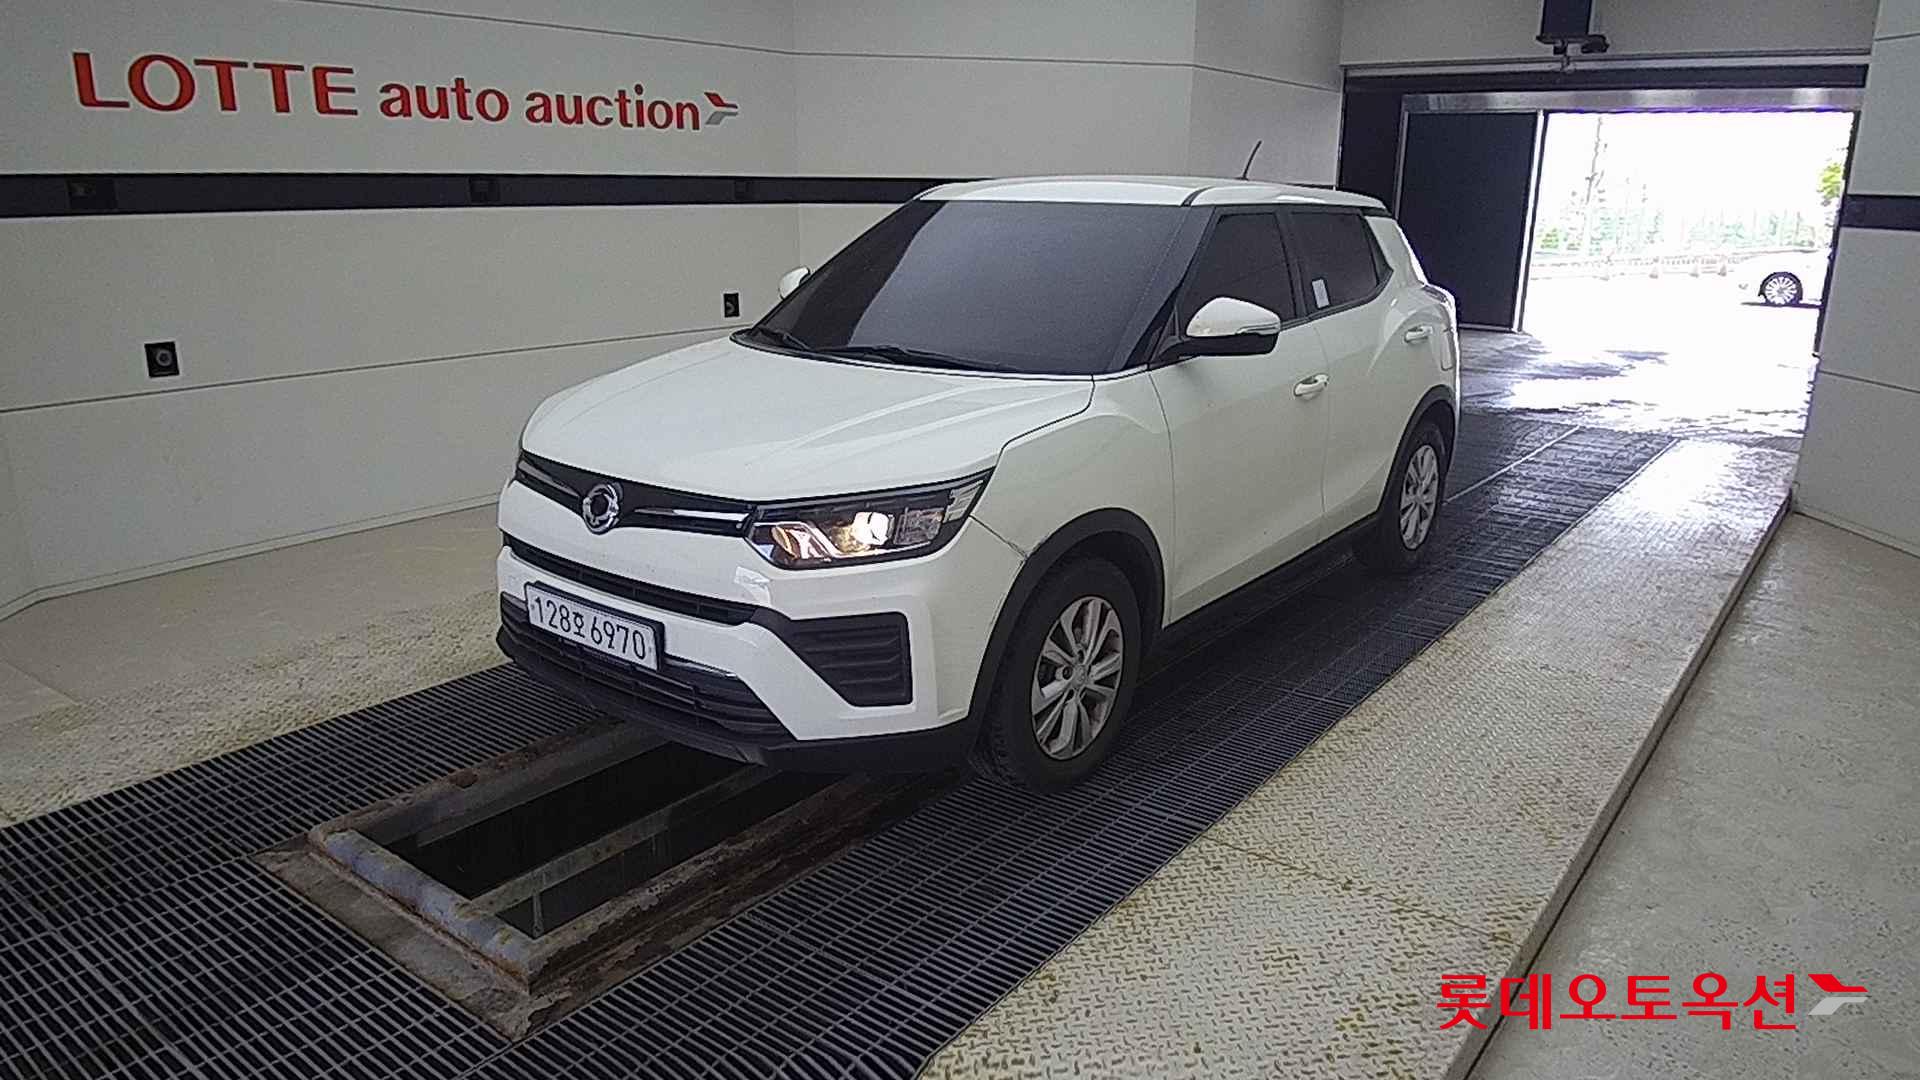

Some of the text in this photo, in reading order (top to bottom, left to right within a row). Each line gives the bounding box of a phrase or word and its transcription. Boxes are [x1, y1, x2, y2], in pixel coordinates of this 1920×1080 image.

[73, 51, 700, 131] LOTTE auto auction
[590, 615, 647, 660] 6970
